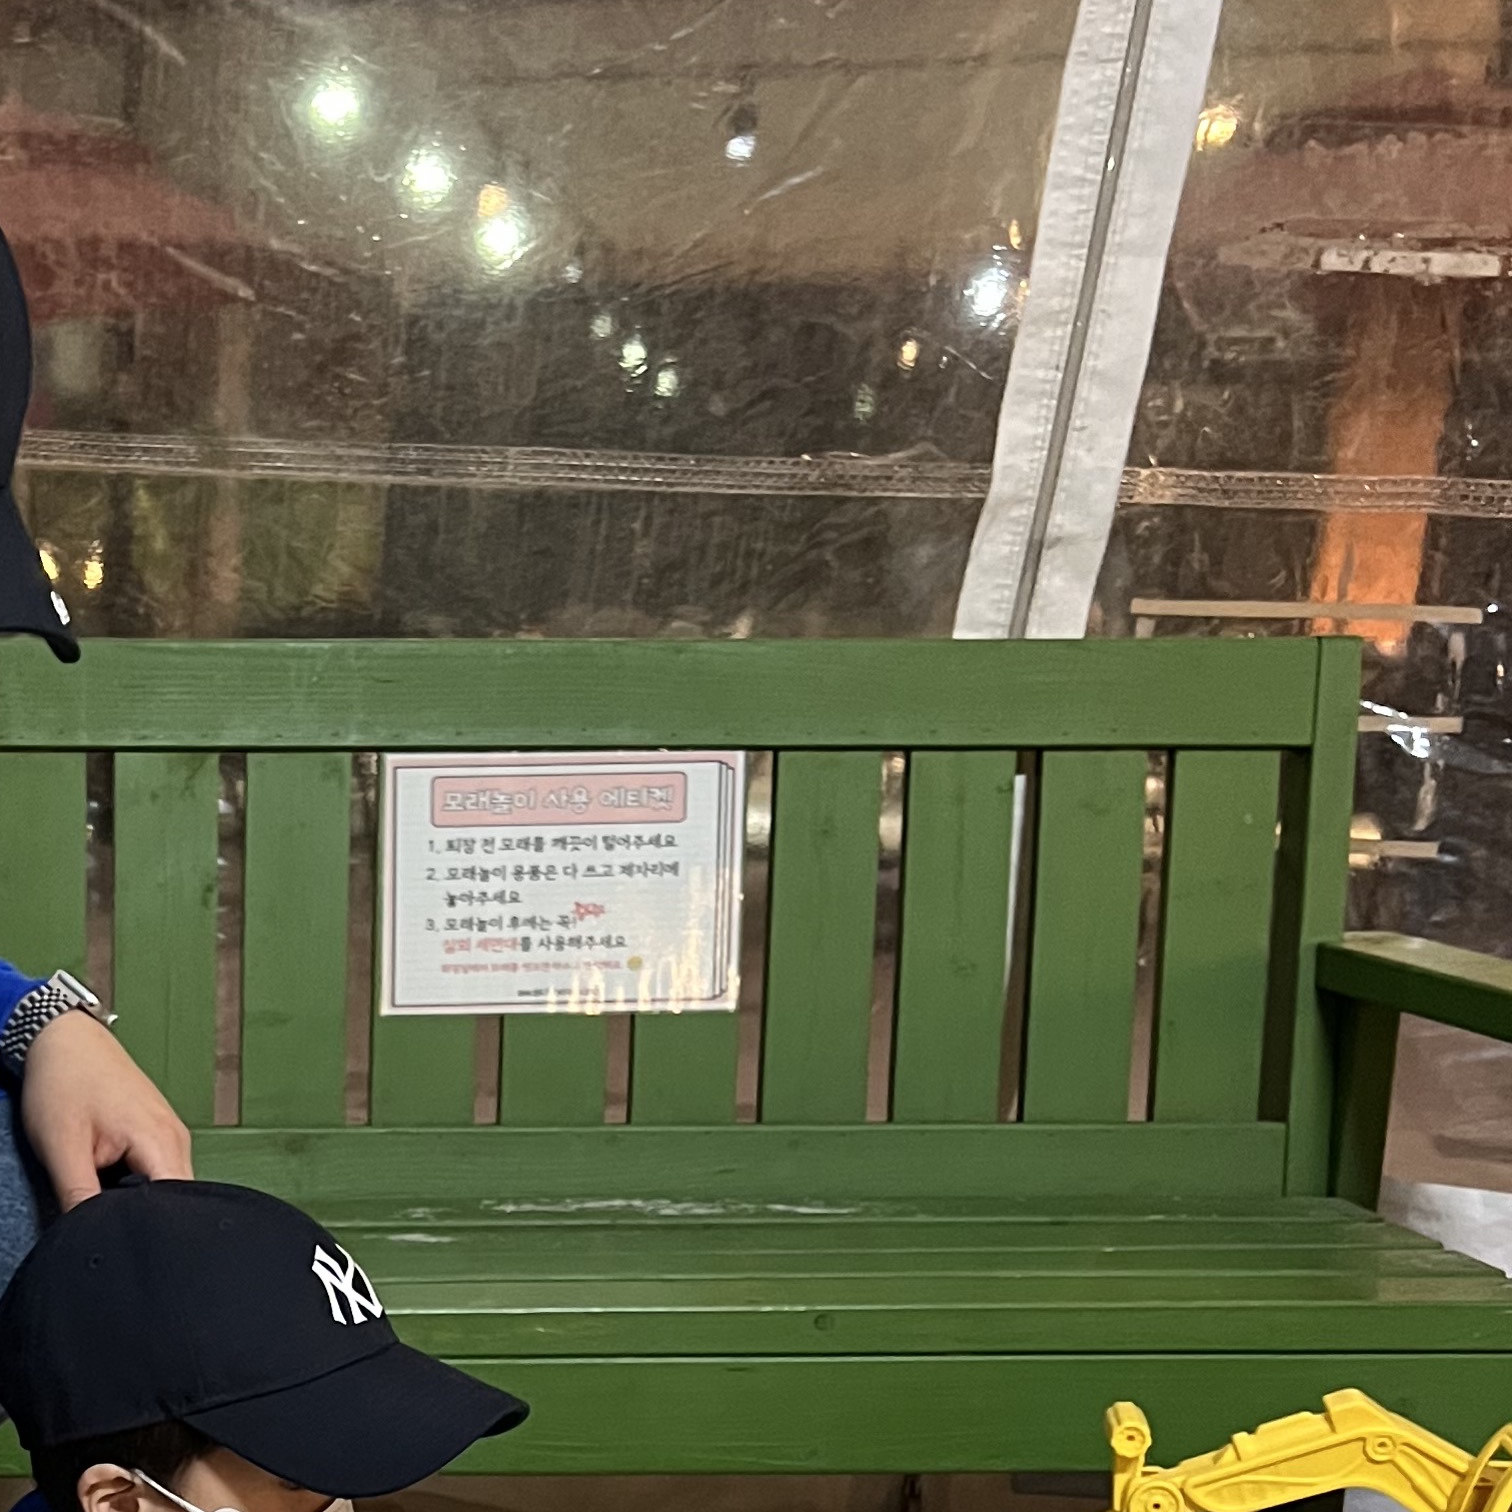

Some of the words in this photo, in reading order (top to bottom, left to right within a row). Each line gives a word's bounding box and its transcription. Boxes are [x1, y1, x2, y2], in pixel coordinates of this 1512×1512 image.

[442, 787, 537, 815] 모래놀이
[542, 785, 589, 814] 사용
[598, 784, 675, 811] 에티켓
[481, 836, 495, 854] 전
[499, 836, 545, 852] 모래를
[602, 833, 678, 851] 털어주세요
[444, 864, 506, 882] 모래놀이
[511, 864, 558, 881] 용품은
[562, 863, 578, 880] 다
[581, 864, 615, 877] 쓰고
[619, 861, 679, 878] 제자리에
[443, 915, 503, 932] 모래놀이
[507, 915, 553, 931] 후에는
[538, 935, 628, 952] 사용해주세요
